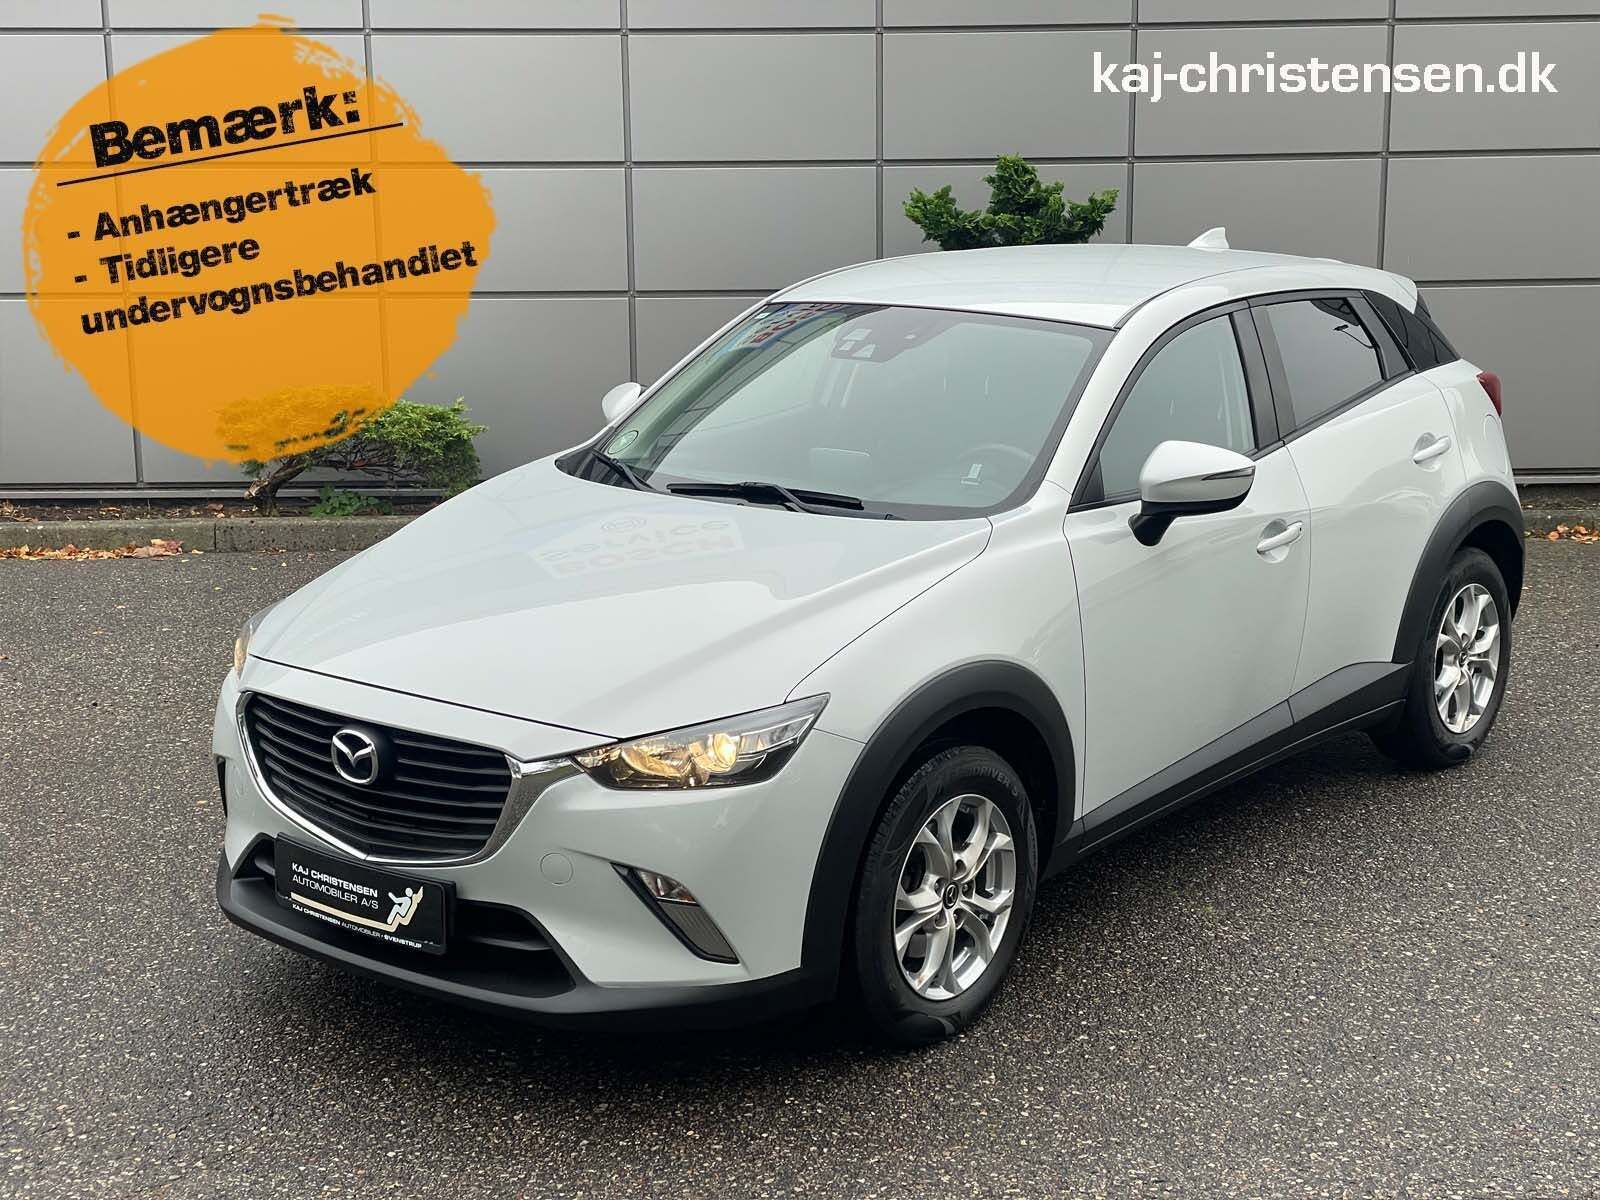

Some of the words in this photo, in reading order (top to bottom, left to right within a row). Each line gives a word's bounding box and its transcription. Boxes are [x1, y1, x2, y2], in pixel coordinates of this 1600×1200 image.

[292, 862, 309, 875] KAJ
[311, 870, 378, 898] CHRISTENSEN
[292, 874, 358, 904] AUTOMOBILER
[361, 897, 379, 909] A/S
